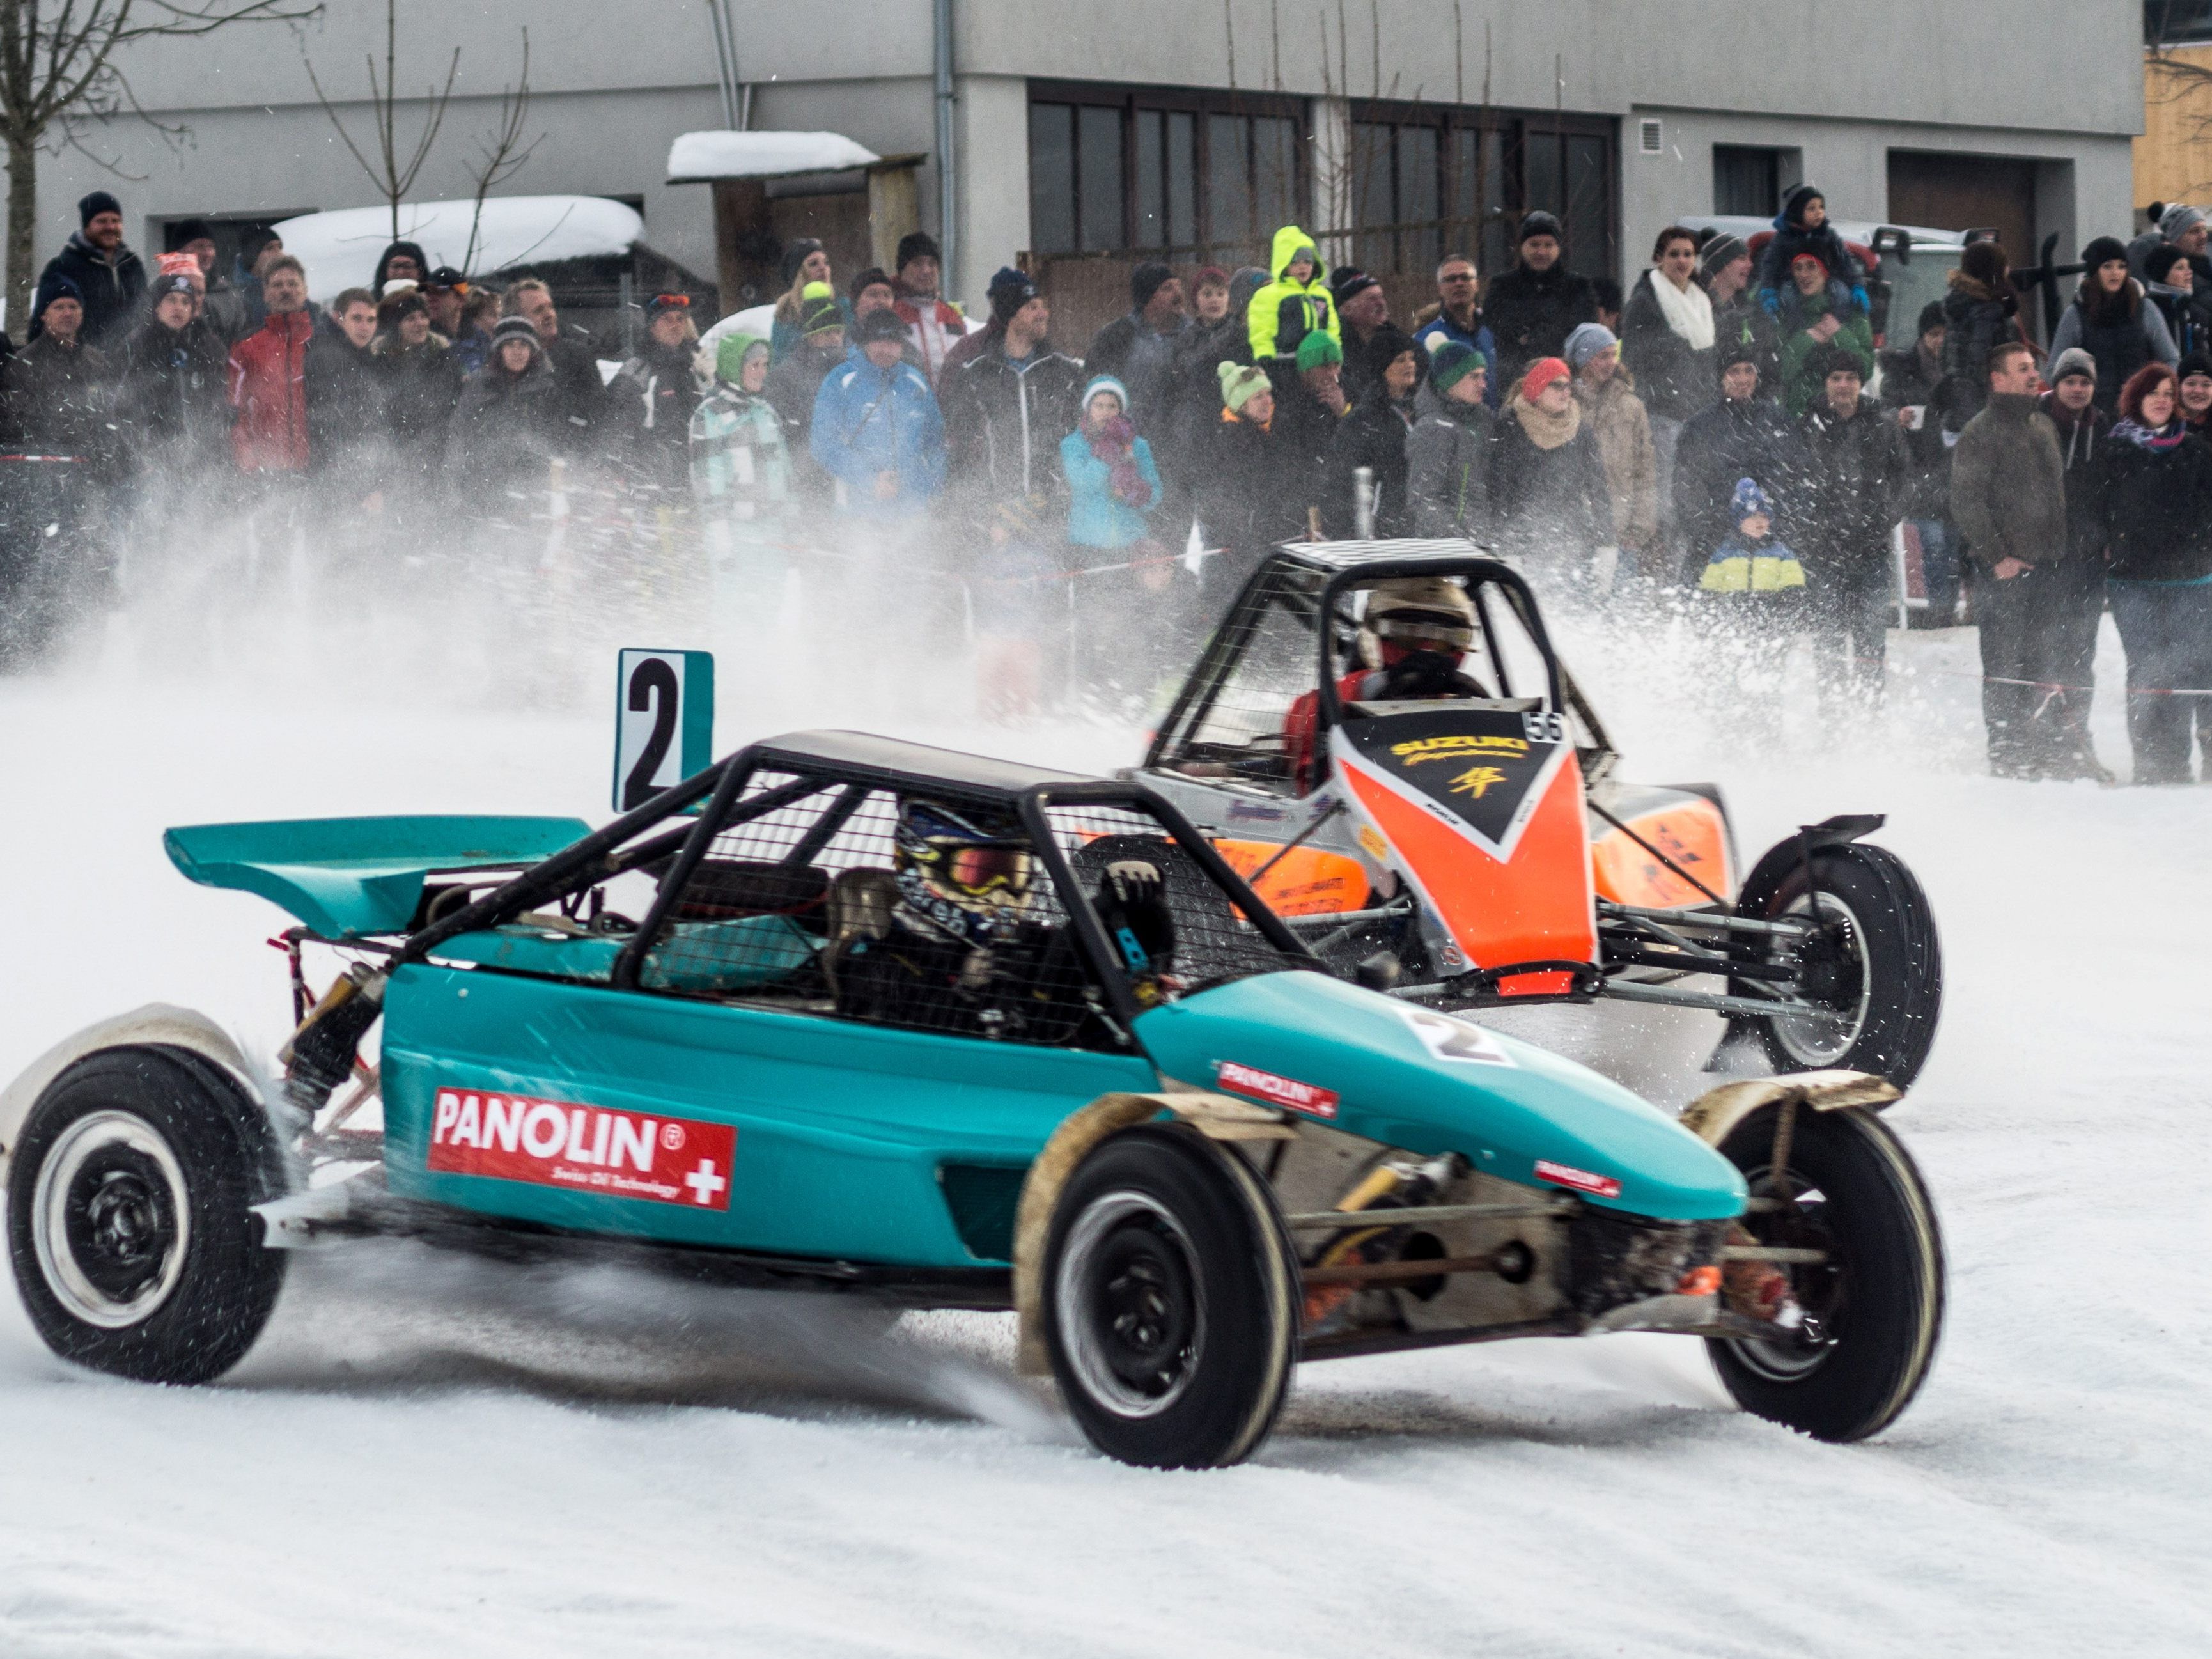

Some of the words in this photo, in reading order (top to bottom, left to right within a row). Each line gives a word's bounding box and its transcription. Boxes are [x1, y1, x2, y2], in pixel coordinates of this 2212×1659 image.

[623, 657, 678, 812] 2
[1390, 736, 1530, 756] SUZUKI
[1412, 1013, 1505, 1062] 2
